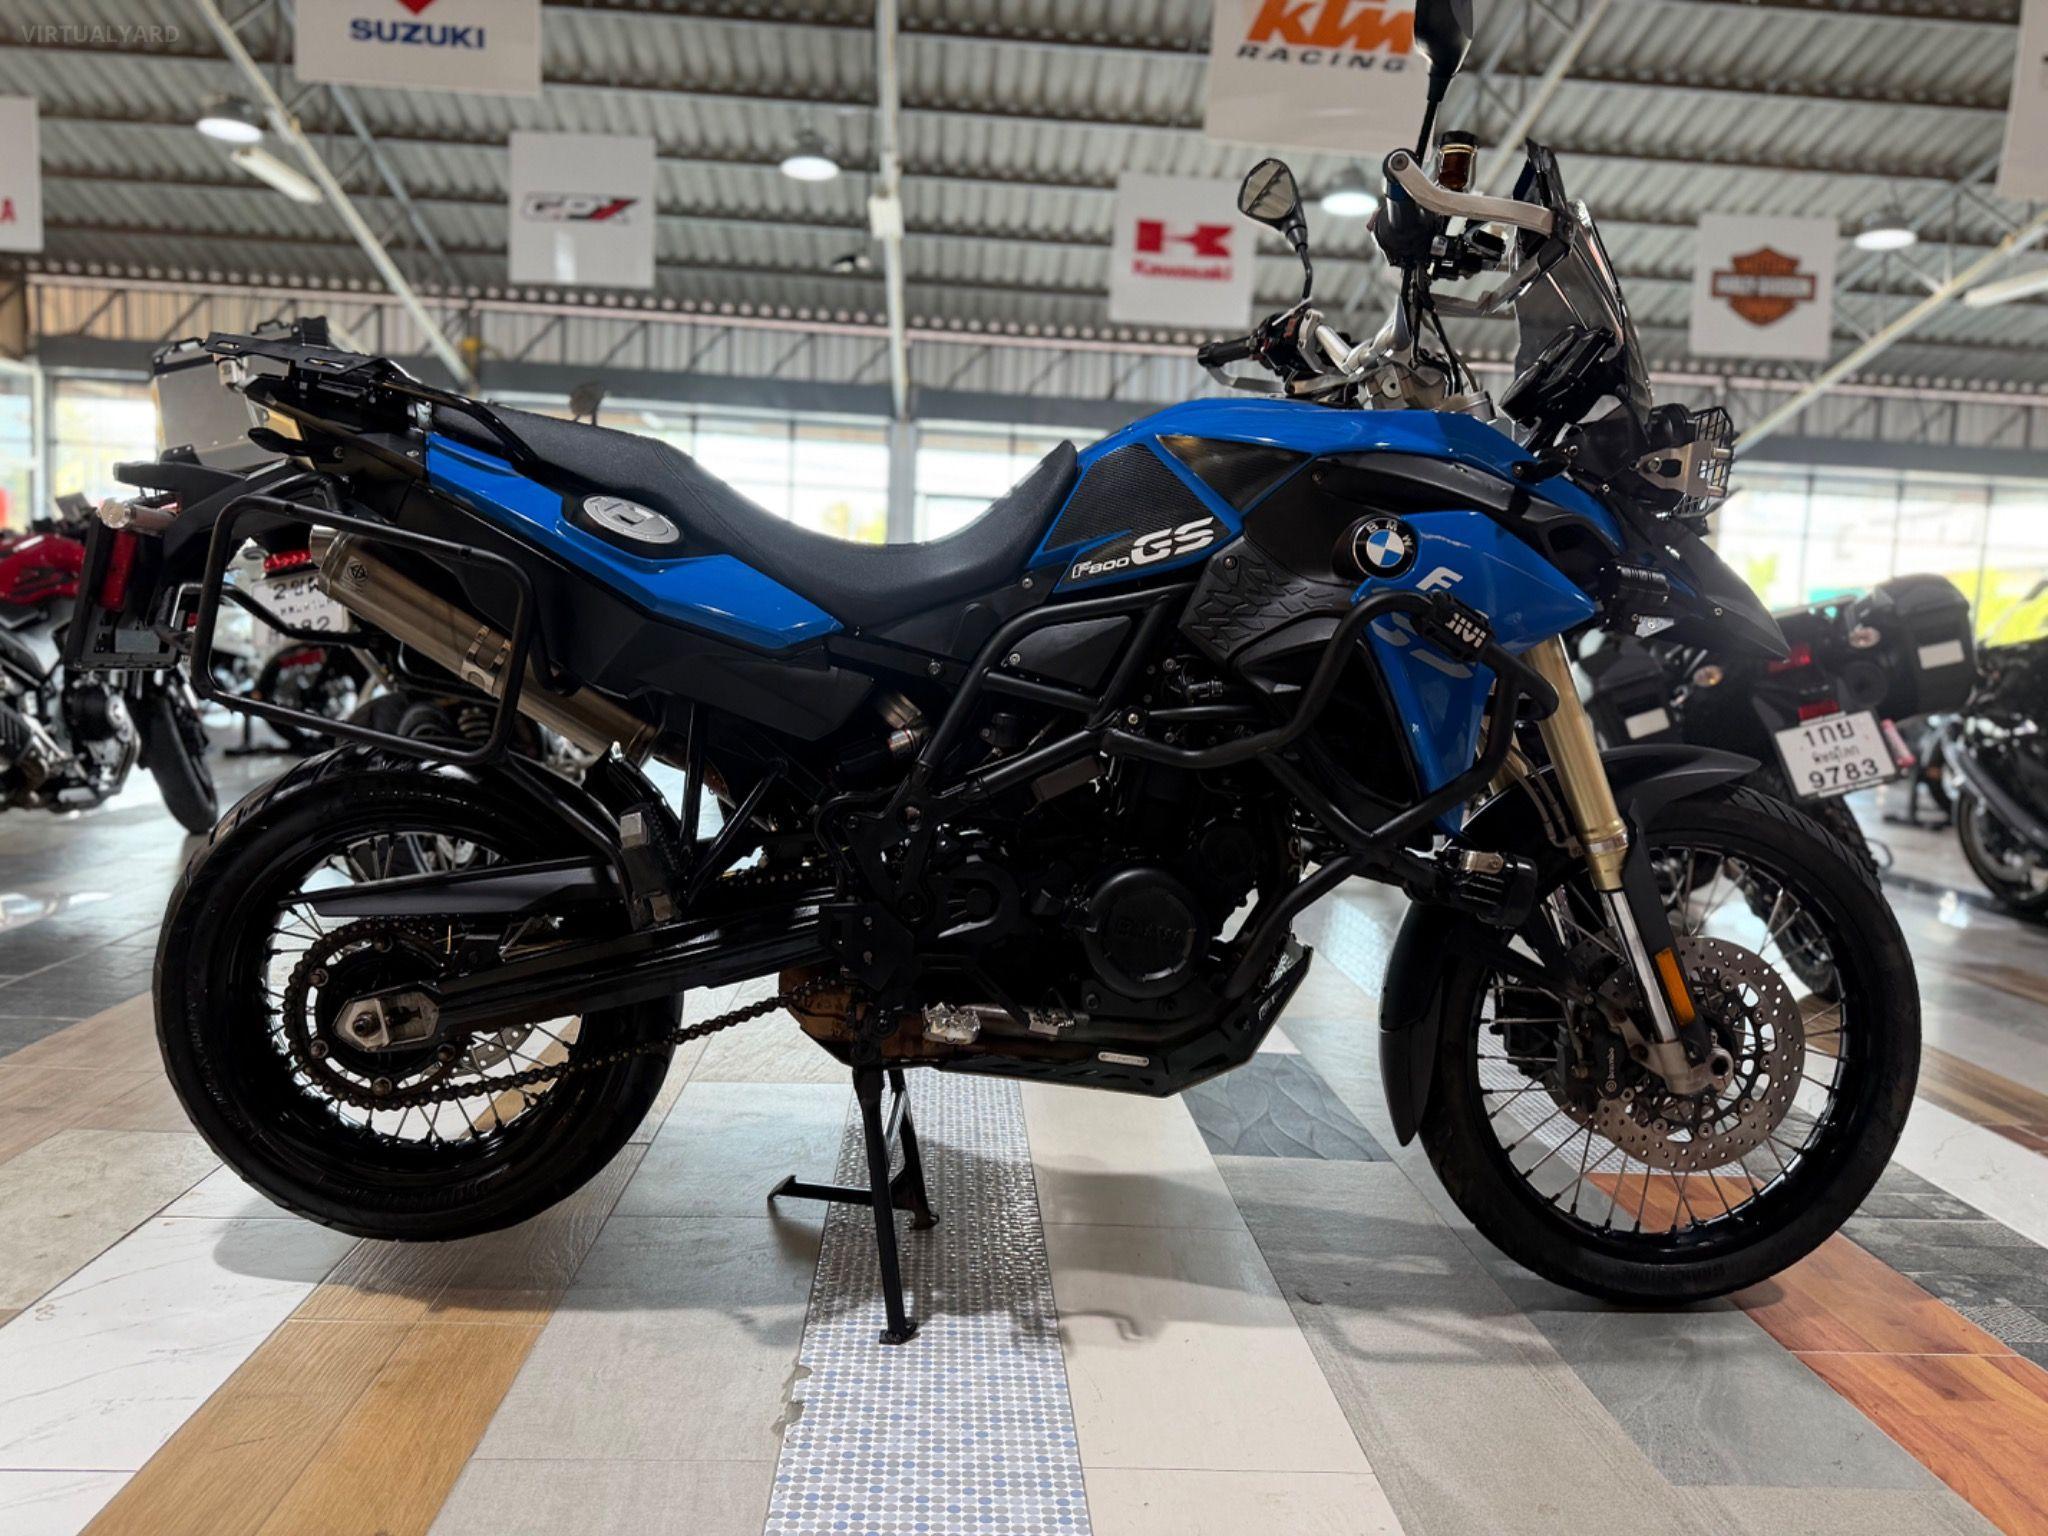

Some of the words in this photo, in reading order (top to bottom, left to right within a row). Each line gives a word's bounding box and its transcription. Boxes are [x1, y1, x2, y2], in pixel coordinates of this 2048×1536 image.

[350, 18, 486, 49] SUZUKI
[1236, 45, 1407, 72] RACING
[1366, 518, 1414, 547] BMW
[1808, 758, 1879, 790] 9783
